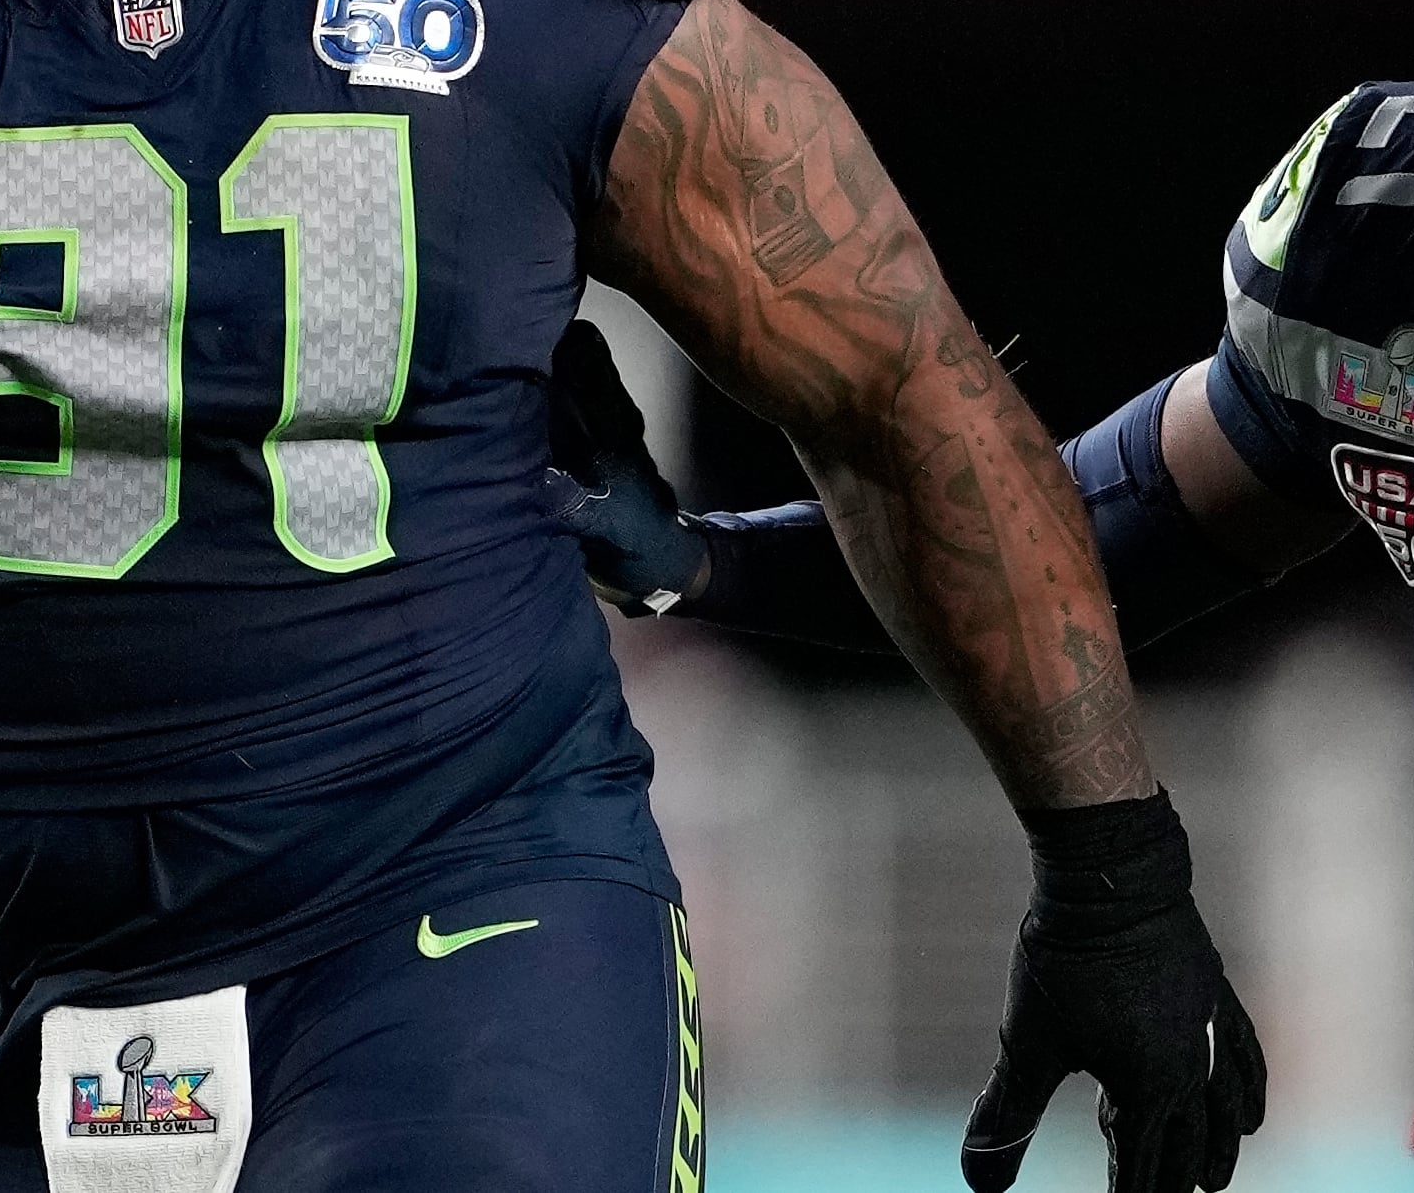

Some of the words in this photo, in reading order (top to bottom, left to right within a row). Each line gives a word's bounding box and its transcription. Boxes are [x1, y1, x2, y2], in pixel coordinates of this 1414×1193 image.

[126, 10, 172, 43] NFL
[1346, 406, 1397, 431] SUPER
[87, 1122, 144, 1135] SUPER
[150, 1120, 198, 1134] BOWL
